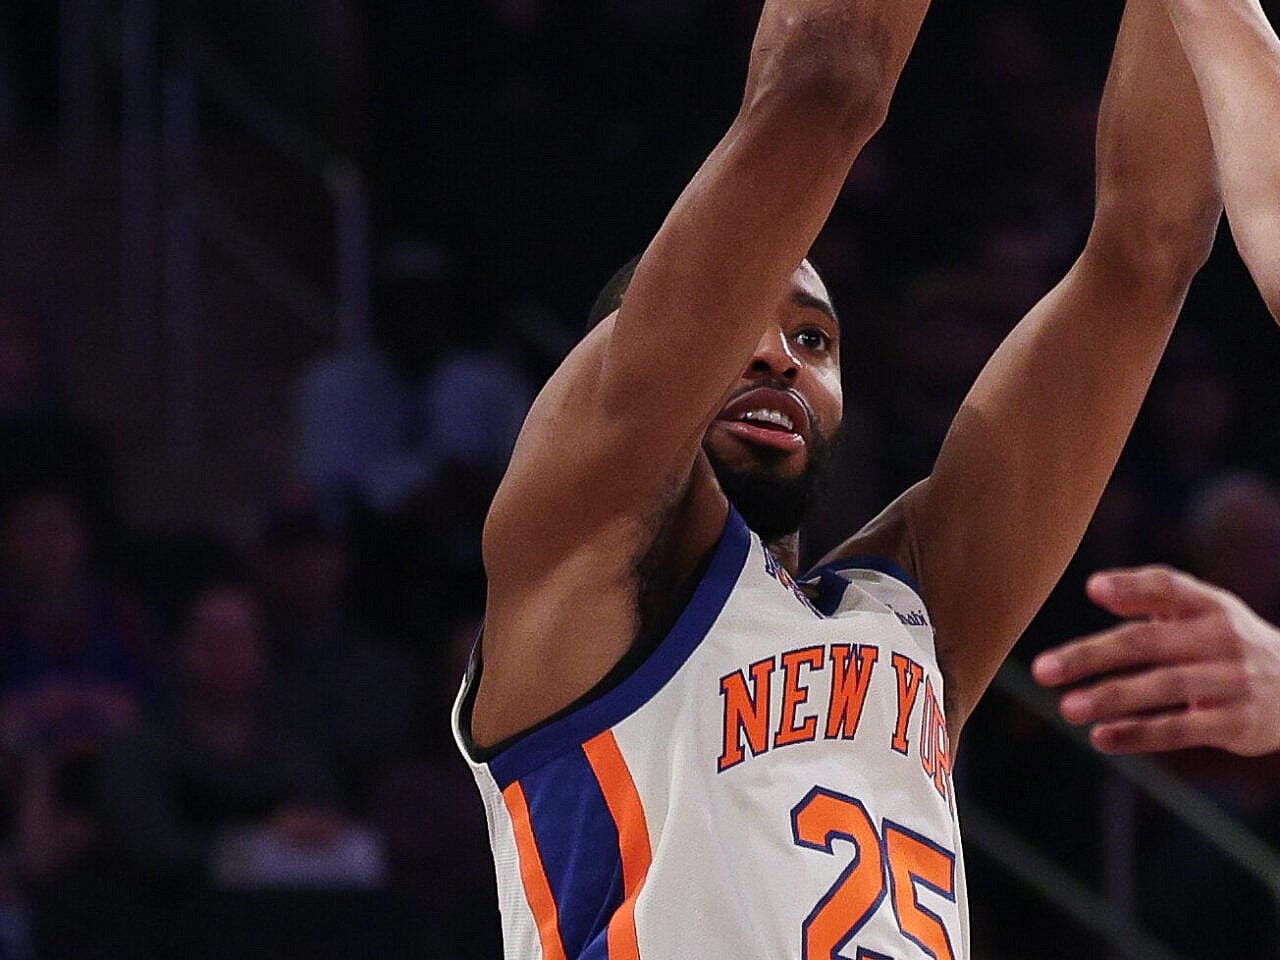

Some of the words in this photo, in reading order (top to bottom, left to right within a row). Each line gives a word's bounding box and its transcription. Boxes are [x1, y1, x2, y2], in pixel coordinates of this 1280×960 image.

[717, 643, 879, 773] NEW
[890, 650, 955, 823] YOR
[790, 784, 956, 960] 25
